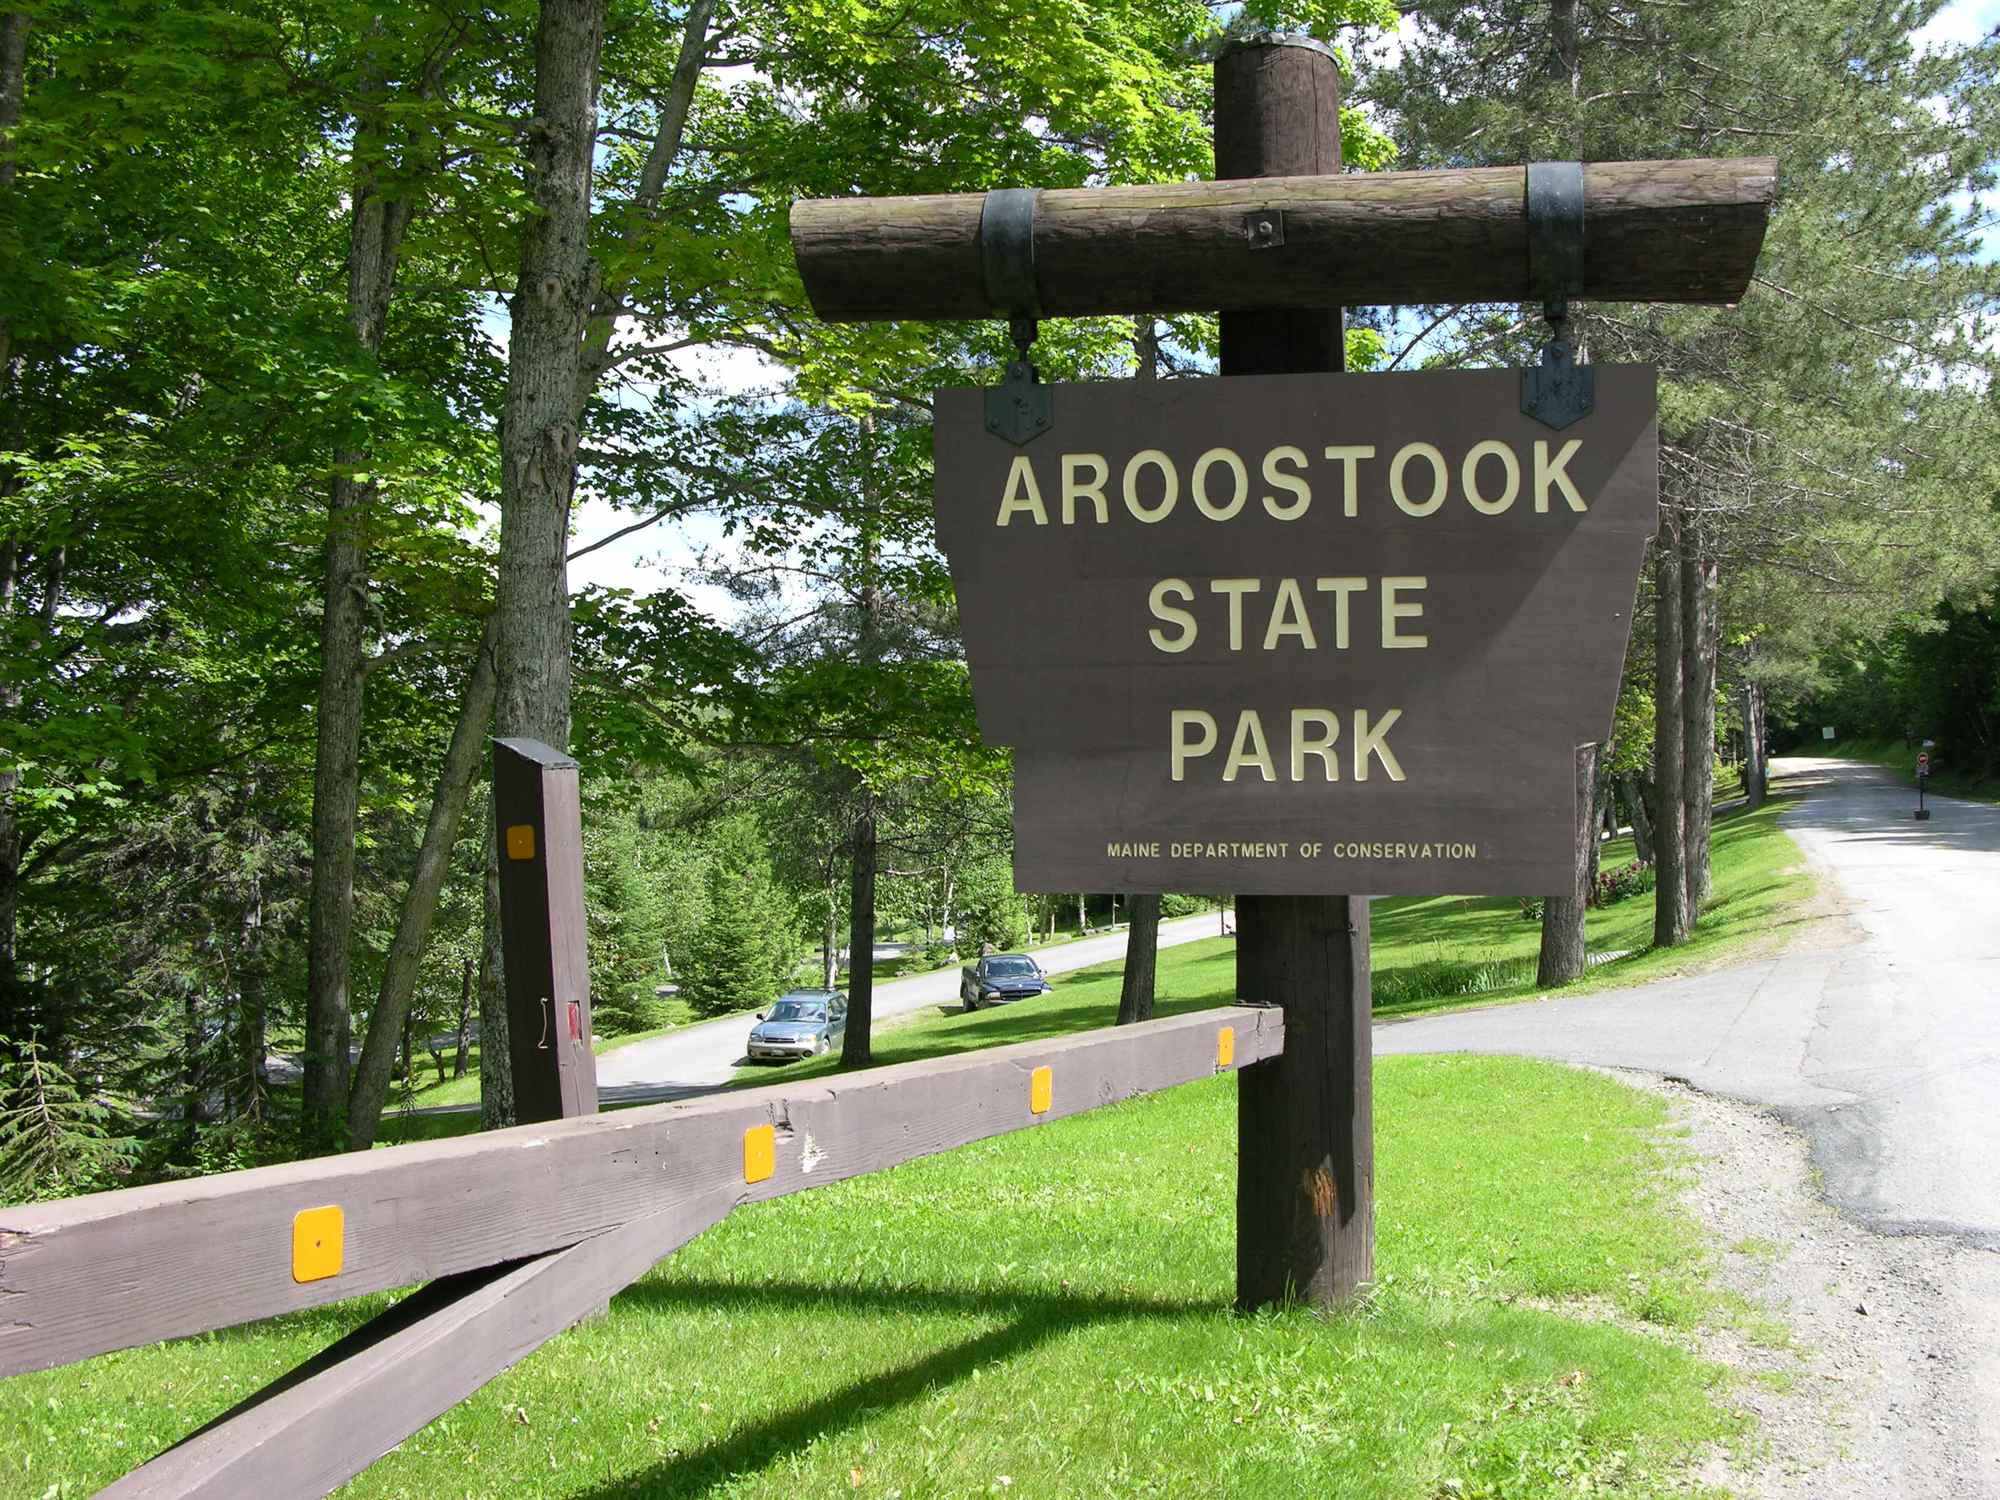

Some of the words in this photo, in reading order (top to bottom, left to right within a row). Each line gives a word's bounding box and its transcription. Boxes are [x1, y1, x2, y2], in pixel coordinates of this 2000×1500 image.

[996, 439, 1588, 527] AROOSTOOK
[1148, 576, 1430, 654] STATE
[1171, 708, 1407, 783] PARK
[1107, 842, 1161, 858] MAINE
[1170, 842, 1289, 858] DEPARTMENT
[1299, 842, 1322, 858] OF
[1333, 842, 1477, 858] CONSERVATION
